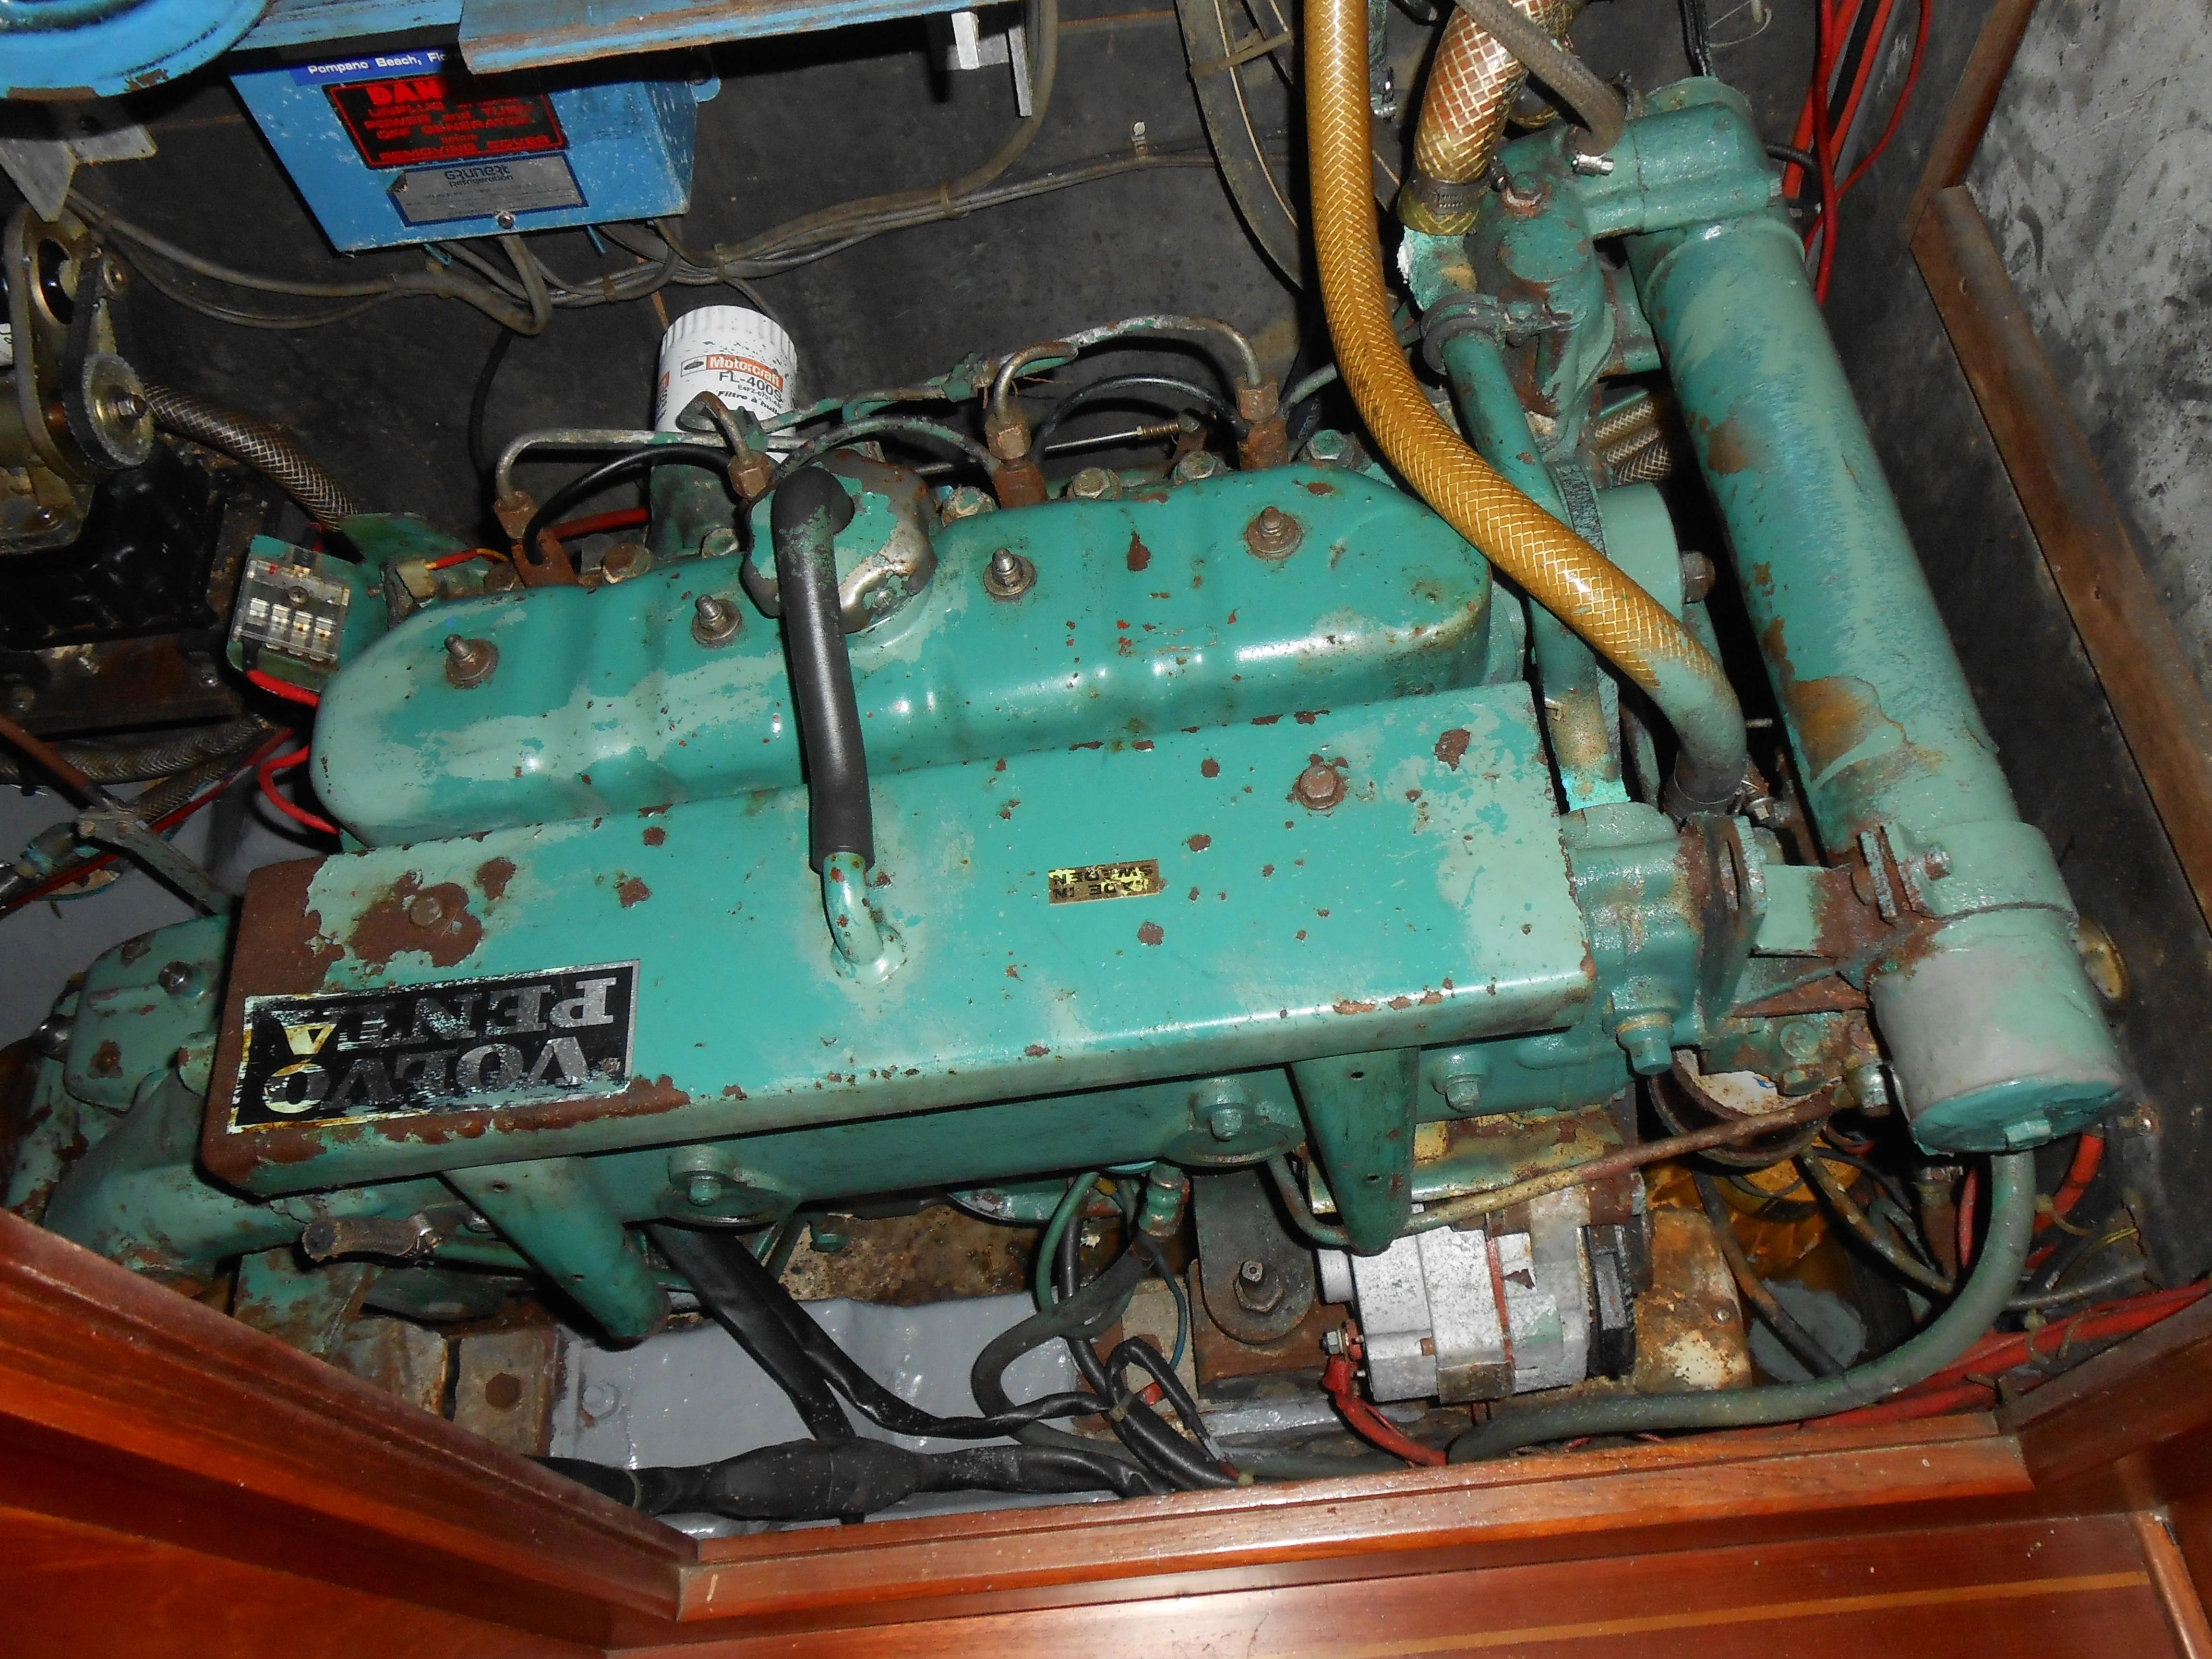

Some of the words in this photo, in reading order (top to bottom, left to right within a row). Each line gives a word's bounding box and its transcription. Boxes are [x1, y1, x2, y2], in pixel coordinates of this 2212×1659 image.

[307, 61, 369, 74] Pompano
[375, 54, 422, 68] Beach,
[427, 52, 451, 62] Flo
[366, 77, 444, 106] DAN
[364, 115, 432, 130] POWER
[376, 128, 410, 140] OFF
[421, 116, 533, 135] GENERATOR
[487, 134, 551, 150] COVER
[710, 356, 781, 387] Motorcraft
[719, 371, 784, 402] FL-400S
[760, 400, 780, 415] huil
[1053, 887, 1075, 898] IN
[270, 977, 617, 1055] PENTA
[263, 1036, 589, 1114] VOLVO
